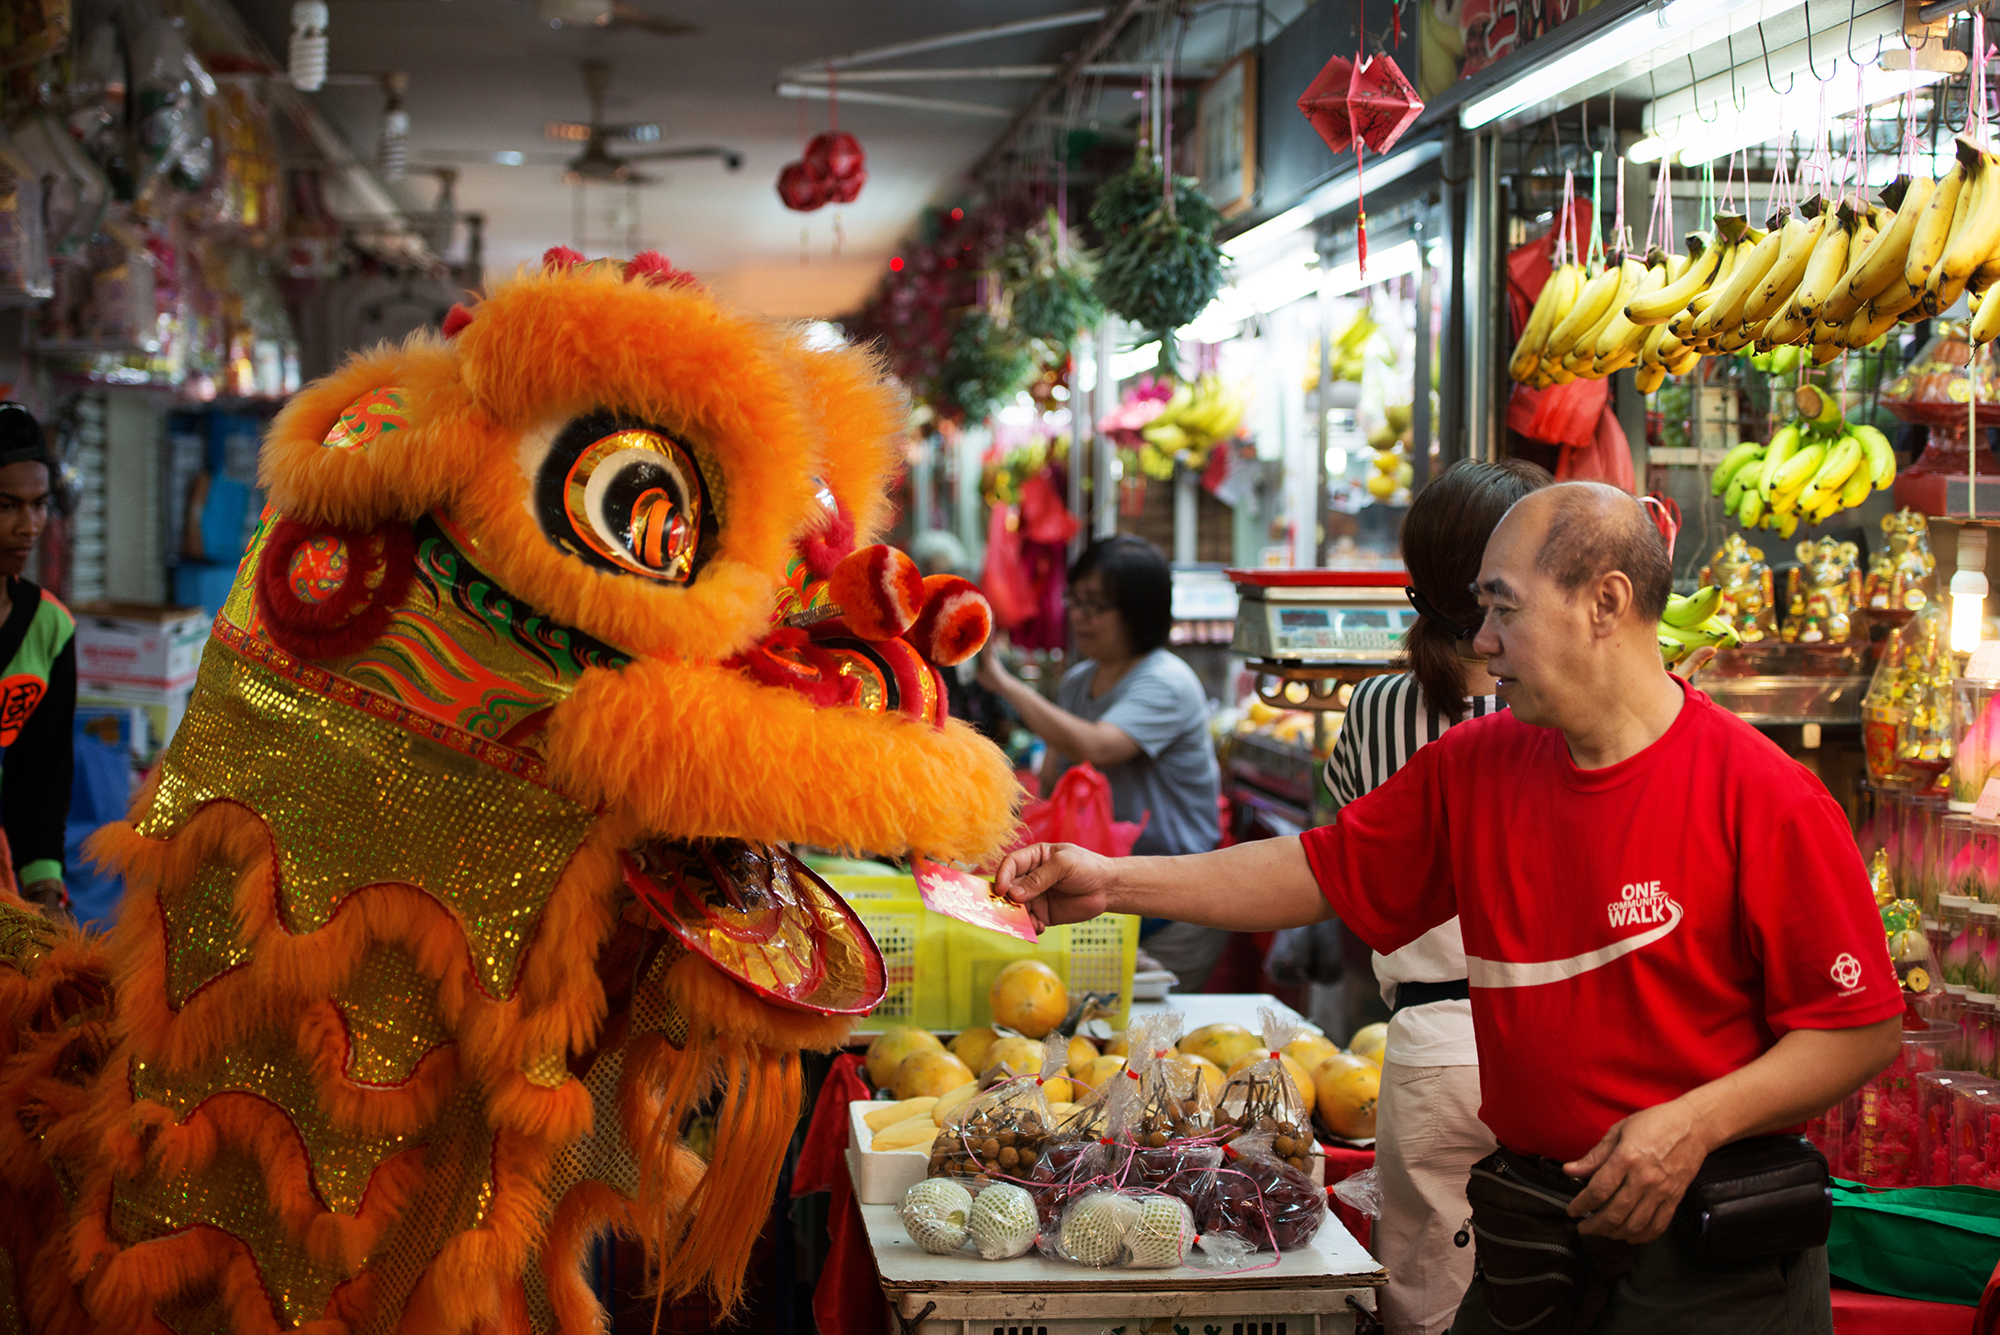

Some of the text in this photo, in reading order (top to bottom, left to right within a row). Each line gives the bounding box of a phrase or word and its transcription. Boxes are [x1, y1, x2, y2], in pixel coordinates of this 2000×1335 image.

[1621, 880, 1661, 901] ONE
[1607, 896, 1664, 912] COMMUNITY
[1607, 903, 1666, 928] WALK
